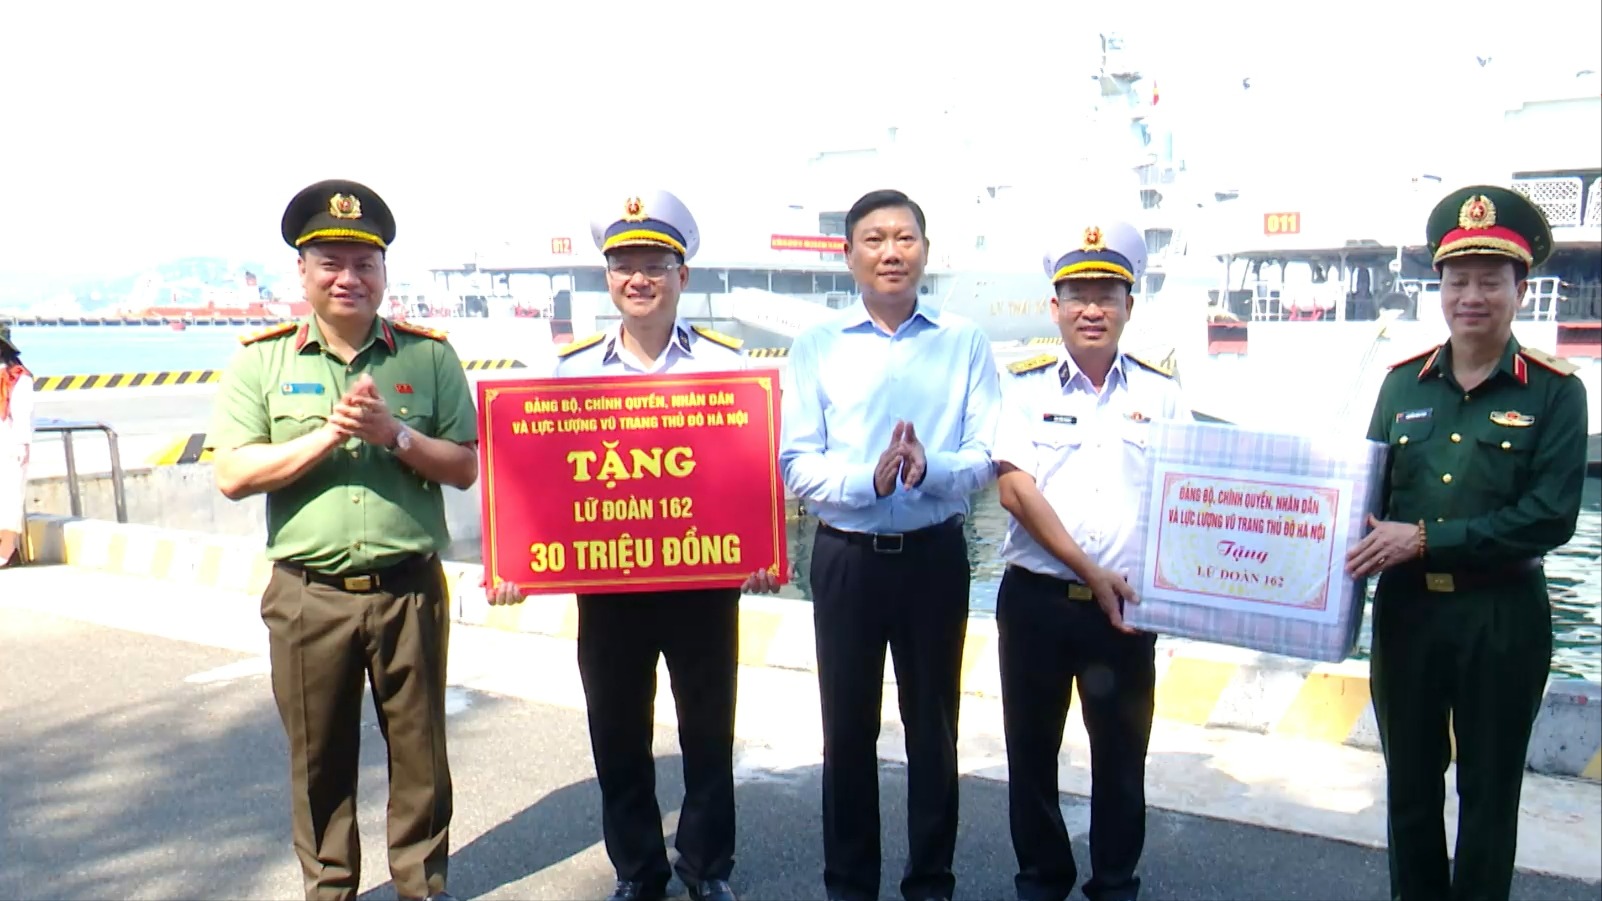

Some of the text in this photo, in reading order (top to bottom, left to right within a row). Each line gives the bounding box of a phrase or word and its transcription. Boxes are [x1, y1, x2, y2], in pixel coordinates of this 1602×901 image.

[1267, 214, 1297, 232] 011
[524, 396, 558, 414] ĐẢNG
[561, 397, 582, 414] BỘ,
[585, 396, 622, 412] CHÍNH
[671, 391, 706, 408] NHÂN
[708, 390, 735, 406] DÂN
[512, 409, 749, 436] VÀ LỰC LƯỢNG VŨ TRANG THỦ ĐÔ HÀ NỘI
[567, 440, 697, 489] TẶNG
[574, 494, 693, 523] LỮ ĐOÀN 162
[1276, 494, 1299, 512] NHÂN
[1301, 496, 1319, 515] DÂN
[1168, 506, 1327, 543] VÀ LỰC LƯỢNG VŨ TRANG THỦ ĐÔ HÀ NỘI
[530, 525, 741, 575] 30 TRIỆU ĐỒNG
[1217, 540, 1269, 564] Tặng
[1264, 575, 1285, 588] 162
